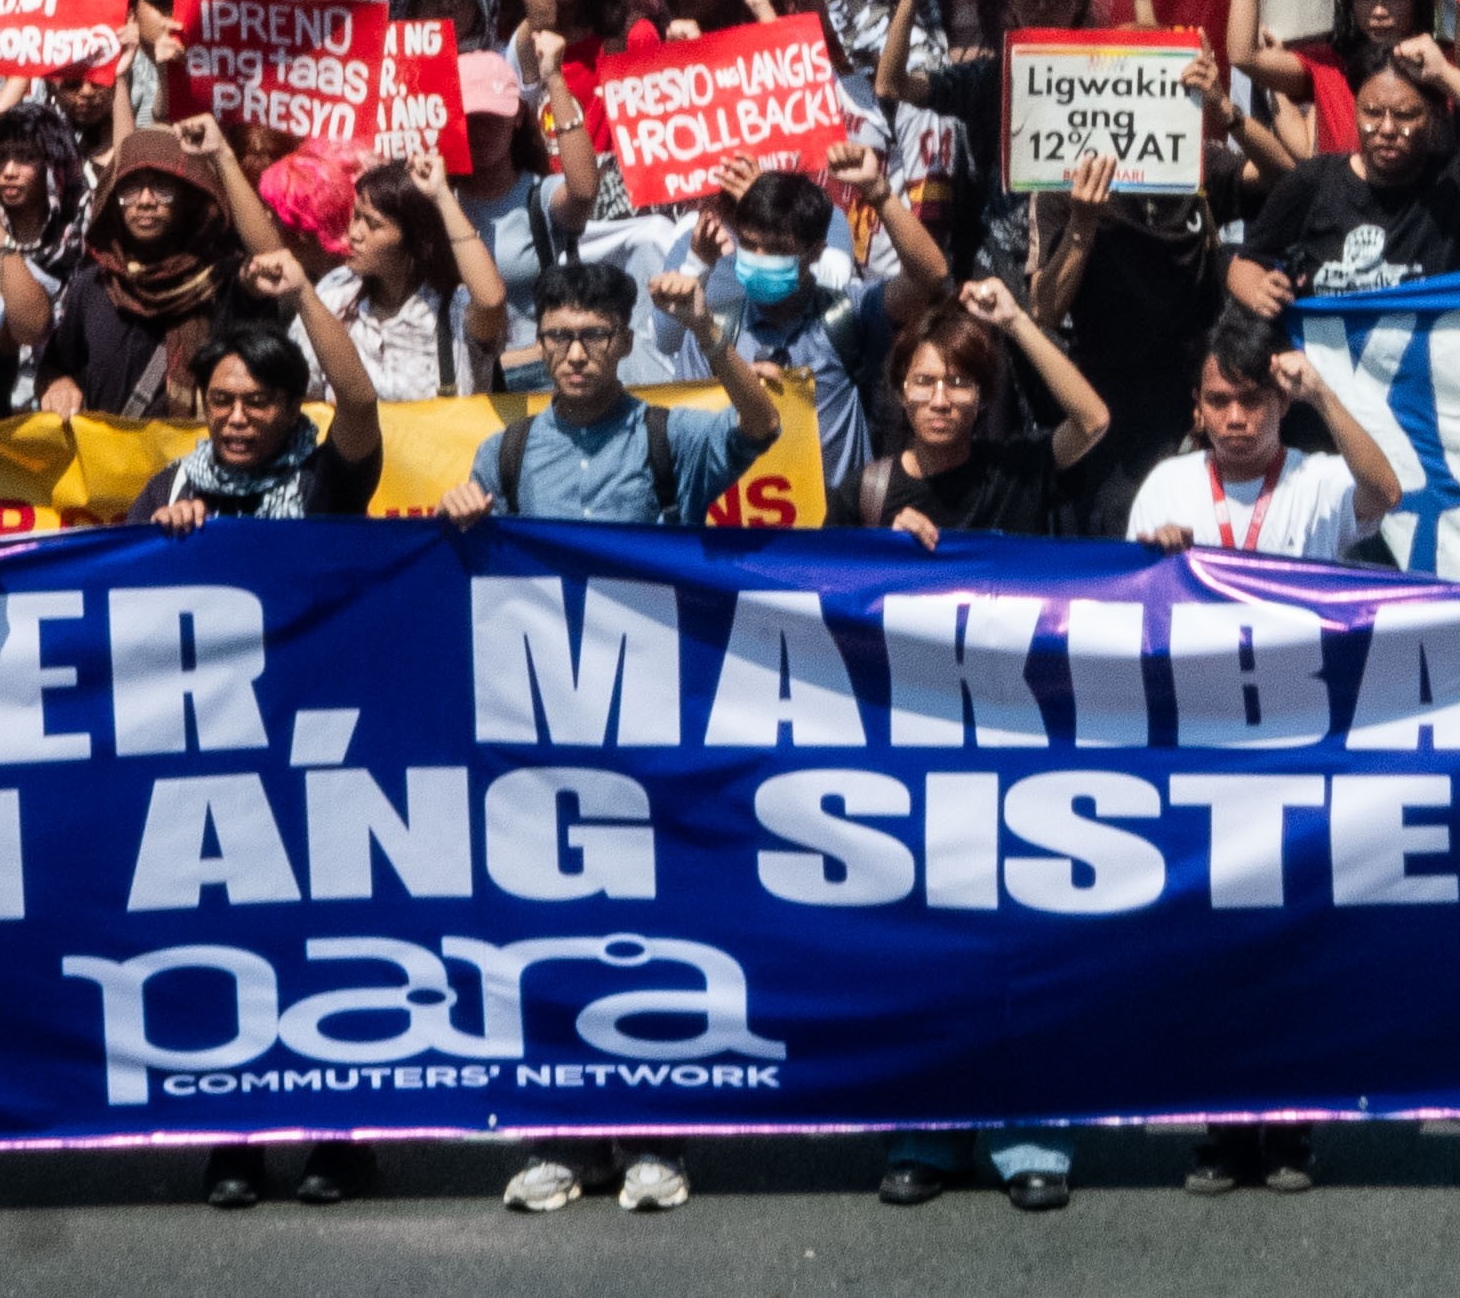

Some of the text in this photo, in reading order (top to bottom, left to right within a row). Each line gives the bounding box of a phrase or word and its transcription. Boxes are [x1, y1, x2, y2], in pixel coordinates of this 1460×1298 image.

[186, 40, 369, 101] ang taas
[1028, 66, 1192, 102] Ligwakin
[212, 83, 357, 138] PRESYO
[739, 82, 842, 136] BACK!
[1066, 109, 1136, 143] ang
[1029, 131, 1187, 164] 12% VAT
[130, 762, 657, 906] ANG
[62, 929, 786, 1107] para
[161, 1061, 783, 1095] COMMUTERS' NETWORK
